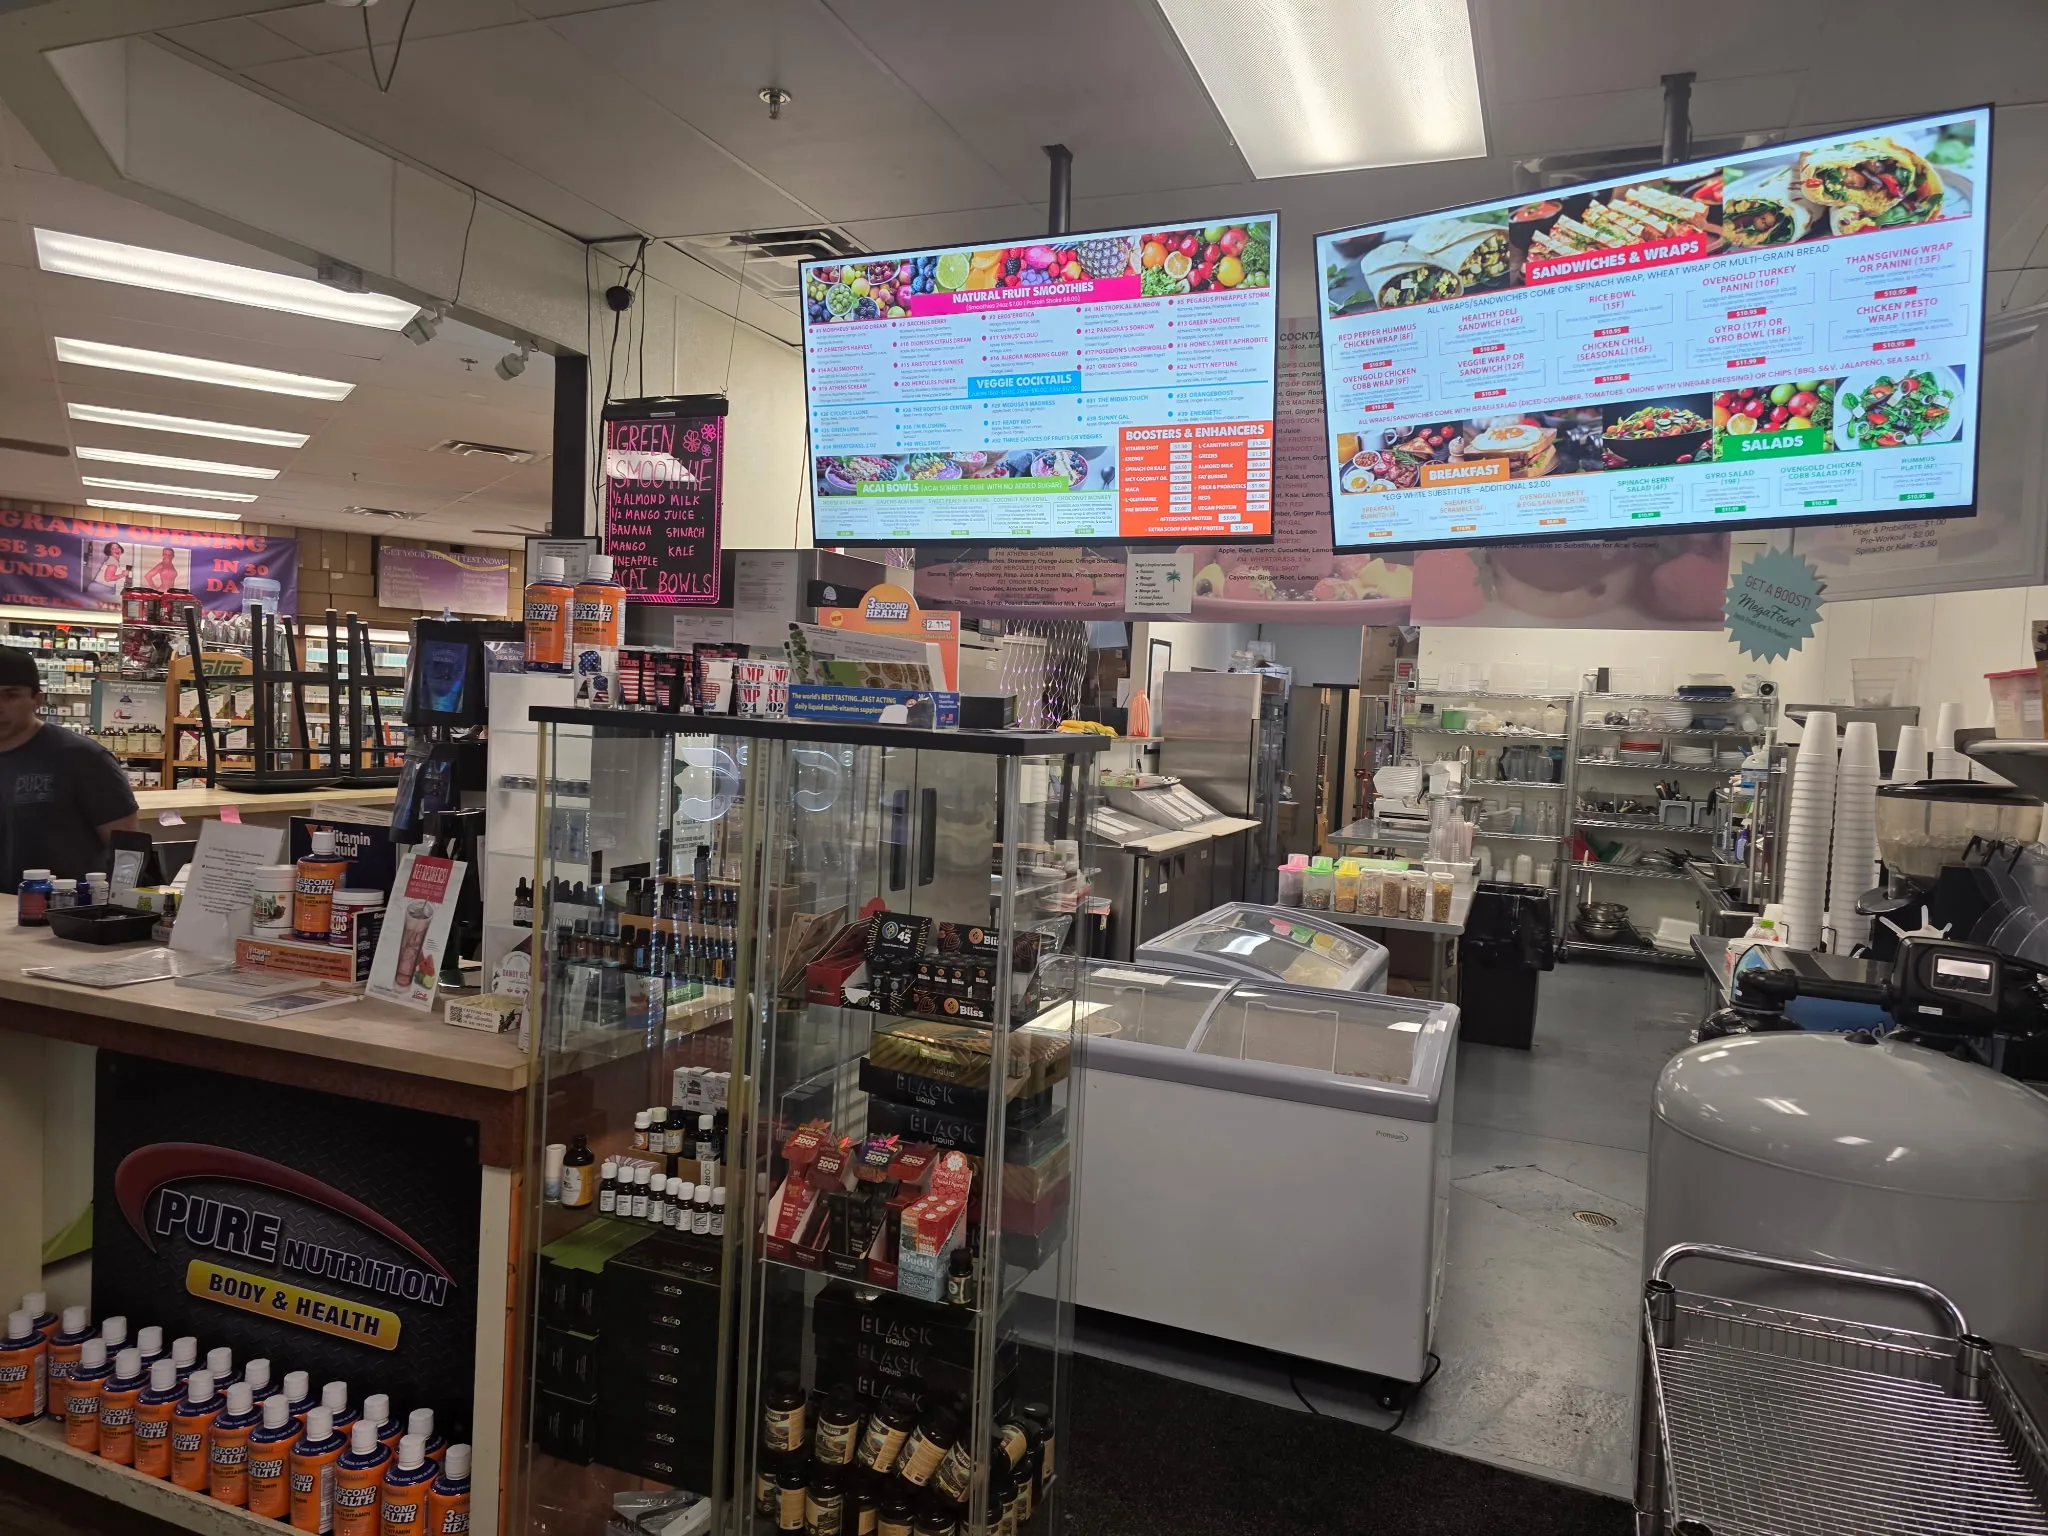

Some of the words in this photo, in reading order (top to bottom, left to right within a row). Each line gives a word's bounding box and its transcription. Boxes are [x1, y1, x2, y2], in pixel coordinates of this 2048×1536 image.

[1533, 254, 1626, 280] SANDWICHES
[1630, 251, 1640, 263] &
[1644, 240, 1699, 261] WRAPS
[1846, 246, 1918, 264] THANSGIVING
[1921, 242, 1953, 254] WRAP
[1859, 264, 1873, 273] OR
[1876, 259, 1912, 272] PANINI
[1914, 254, 1940, 267] (13F)
[1427, 305, 1440, 314] ALL
[1441, 292, 1528, 312] WRAPS/SANDWICHES
[1530, 287, 1555, 299] COME
[1558, 284, 1573, 294] ON:
[1575, 279, 1614, 291] SPINACH
[1616, 273, 1645, 287] WRAP,
[1648, 268, 1679, 280] WHEAT
[1683, 263, 1710, 274] WRAP
[1713, 261, 1726, 270] OR
[1729, 250, 1794, 268] MULTI-GRAIN
[1797, 244, 1829, 258] BREAD
[1702, 271, 1756, 286] OVENGOLD
[1758, 265, 1797, 278] TURKEY
[953, 290, 1000, 303] NATURAL
[1002, 286, 1031, 299] FRUIT
[1033, 281, 1094, 297] SMOOTHIES
[1720, 282, 1753, 293] PANINI
[1756, 278, 1779, 289] (10F)
[1883, 288, 1907, 297] $10.95
[1589, 293, 1609, 303] RICE
[1611, 290, 1636, 300] BOWL
[1603, 301, 1624, 311] (15F)
[1857, 302, 1901, 315] CHICKEN
[1904, 298, 1938, 309] PESTO
[1462, 311, 1496, 322] HEALTHY
[1499, 308, 1517, 318] DELI
[1868, 313, 1899, 324] WRAP
[1901, 309, 1927, 321] (11F)
[1458, 319, 1501, 332] SANDWICH
[1503, 316, 1523, 327] (14F)
[1714, 323, 1741, 334] GYRO
[1743, 320, 1766, 332] (17F)
[1768, 318, 1782, 327] OR
[1708, 333, 1734, 344] GYRO
[1737, 331, 1765, 341] BOWL
[1767, 327, 1790, 338] (18F)
[1582, 340, 1619, 351] CHICKEN
[1622, 336, 1645, 348] CHILI
[1577, 348, 1629, 362] (SEASONAL)
[1630, 345, 1652, 356] (16F)
[1735, 358, 1757, 367] $11.99
[977, 377, 1014, 389] VEGGIE
[1016, 373, 1072, 386] COCKTAILS
[616, 424, 676, 456] GREEN
[1126, 428, 1181, 440] BOOSTERS
[1184, 428, 1193, 438] &
[1195, 425, 1264, 437] ENHANCERS
[1742, 436, 1803, 452] SALADS
[614, 458, 714, 491] SMOOTHIE
[1429, 464, 1499, 481] BREAKFAST
[1705, 472, 1726, 480] GYRO
[1728, 470, 1754, 478] SALAD
[862, 485, 885, 493] ACAI
[886, 483, 919, 492] BOWLS
[1721, 477, 1740, 486] (19F)
[1403, 490, 1426, 499] WHITE
[1428, 487, 1471, 498] SUBSTITUTE
[1529, 480, 1551, 489] $2.00
[623, 493, 665, 505] ALMOND
[671, 494, 700, 505] MILK
[625, 510, 660, 520] MANGO
[665, 510, 694, 520] JUICE
[0, 510, 119, 538] GRAND
[127, 525, 267, 553] OPENING
[612, 523, 652, 536] BANANA
[666, 527, 704, 538] SPINACH
[1853, 526, 1872, 536] Fiber
[1881, 522, 1917, 533] Probiotics
[1861, 532, 1906, 544] Pre-Workout
[35, 543, 62, 558] 30
[611, 541, 646, 551] MANGO
[668, 545, 694, 557] KALE
[1855, 545, 1885, 556] Spinach
[213, 558, 240, 573] IN
[245, 562, 269, 576] 30
[462, 555, 481, 564] TEST
[0, 562, 68, 579] UNDS
[1257, 574, 1278, 582] Ginger
[658, 571, 712, 594] BOWLS
[1745, 575, 1765, 591] GET
[1765, 584, 1773, 596] A
[1774, 586, 1812, 610] BOOST!
[865, 609, 908, 619] HEALTH
[1738, 593, 1801, 628] MegaFood
[795, 703, 807, 711] daily
[808, 704, 823, 712] liquid
[824, 704, 859, 712] multi-vitamin
[876, 696, 896, 704] ACTING
[897, 931, 911, 944] 45
[246, 953, 265, 964] Liquid
[248, 946, 272, 957] Vitamin
[959, 1005, 984, 1018] Bliss
[896, 1073, 955, 1104] BLACK
[915, 1095, 936, 1106] LIQUID
[910, 1114, 977, 1144] BLACK
[795, 1135, 817, 1148] 2000
[932, 1135, 955, 1146] LIQUID
[818, 1159, 839, 1171] 2000
[155, 1188, 281, 1263] PURE
[283, 1238, 448, 1307] NUTRITION
[208, 1272, 266, 1304] BODY
[271, 1290, 289, 1312] &
[295, 1296, 380, 1337] HEALTH
